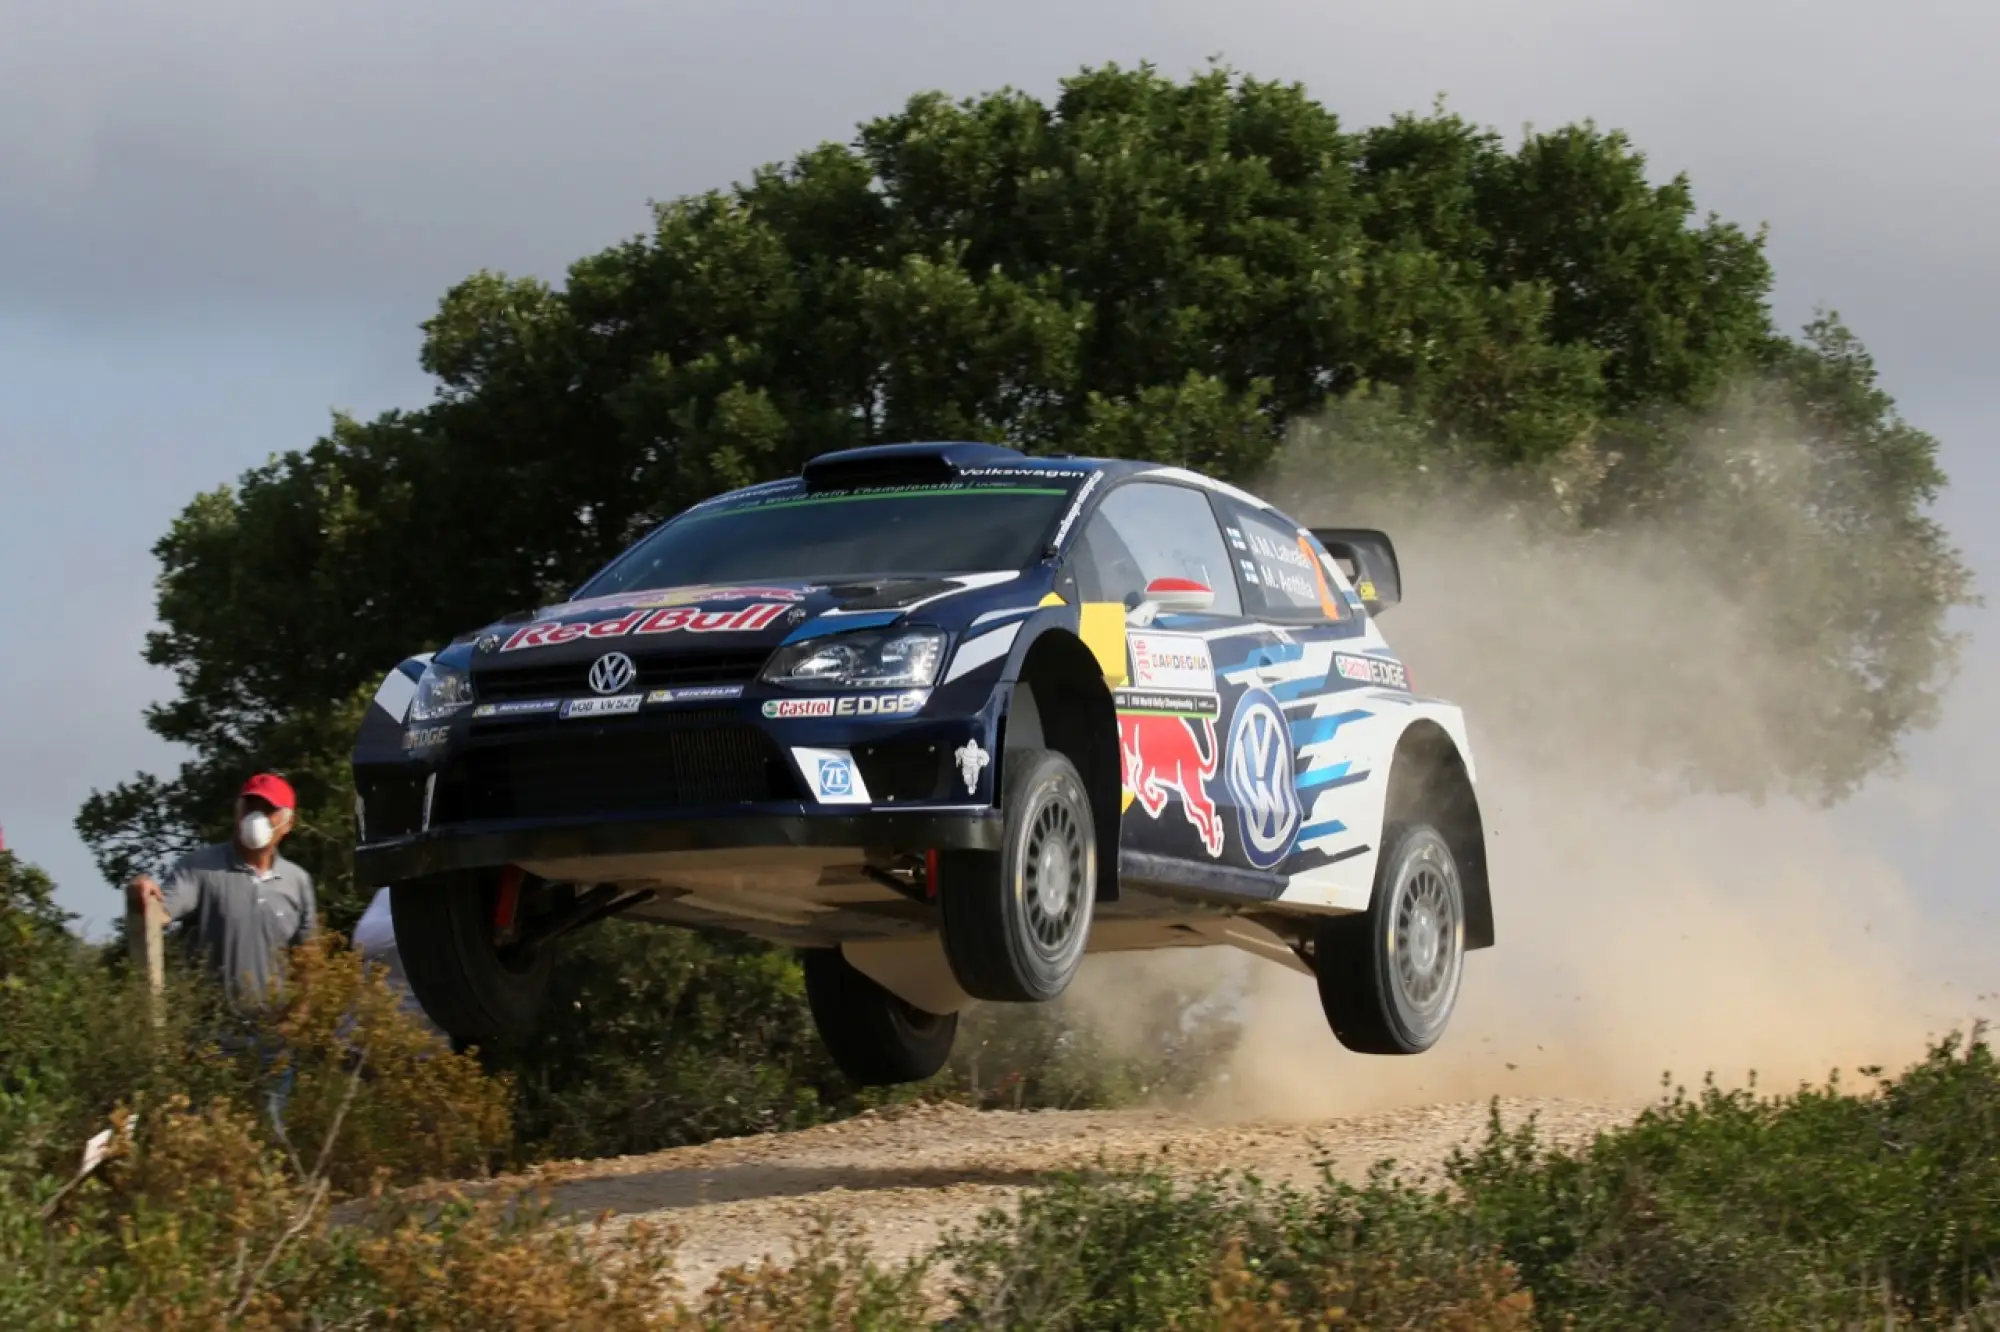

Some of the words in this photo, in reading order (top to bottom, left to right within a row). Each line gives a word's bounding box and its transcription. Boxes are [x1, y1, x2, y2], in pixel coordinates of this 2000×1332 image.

[959, 467, 1086, 479] Volkswagen
[853, 482, 964, 496] Championship
[500, 609, 652, 653] Red
[635, 603, 795, 635] Bull
[1370, 660, 1407, 688] EDGE
[779, 701, 832, 717] Castrol
[836, 694, 917, 715] EDGE
[822, 766, 849, 789] ZF
